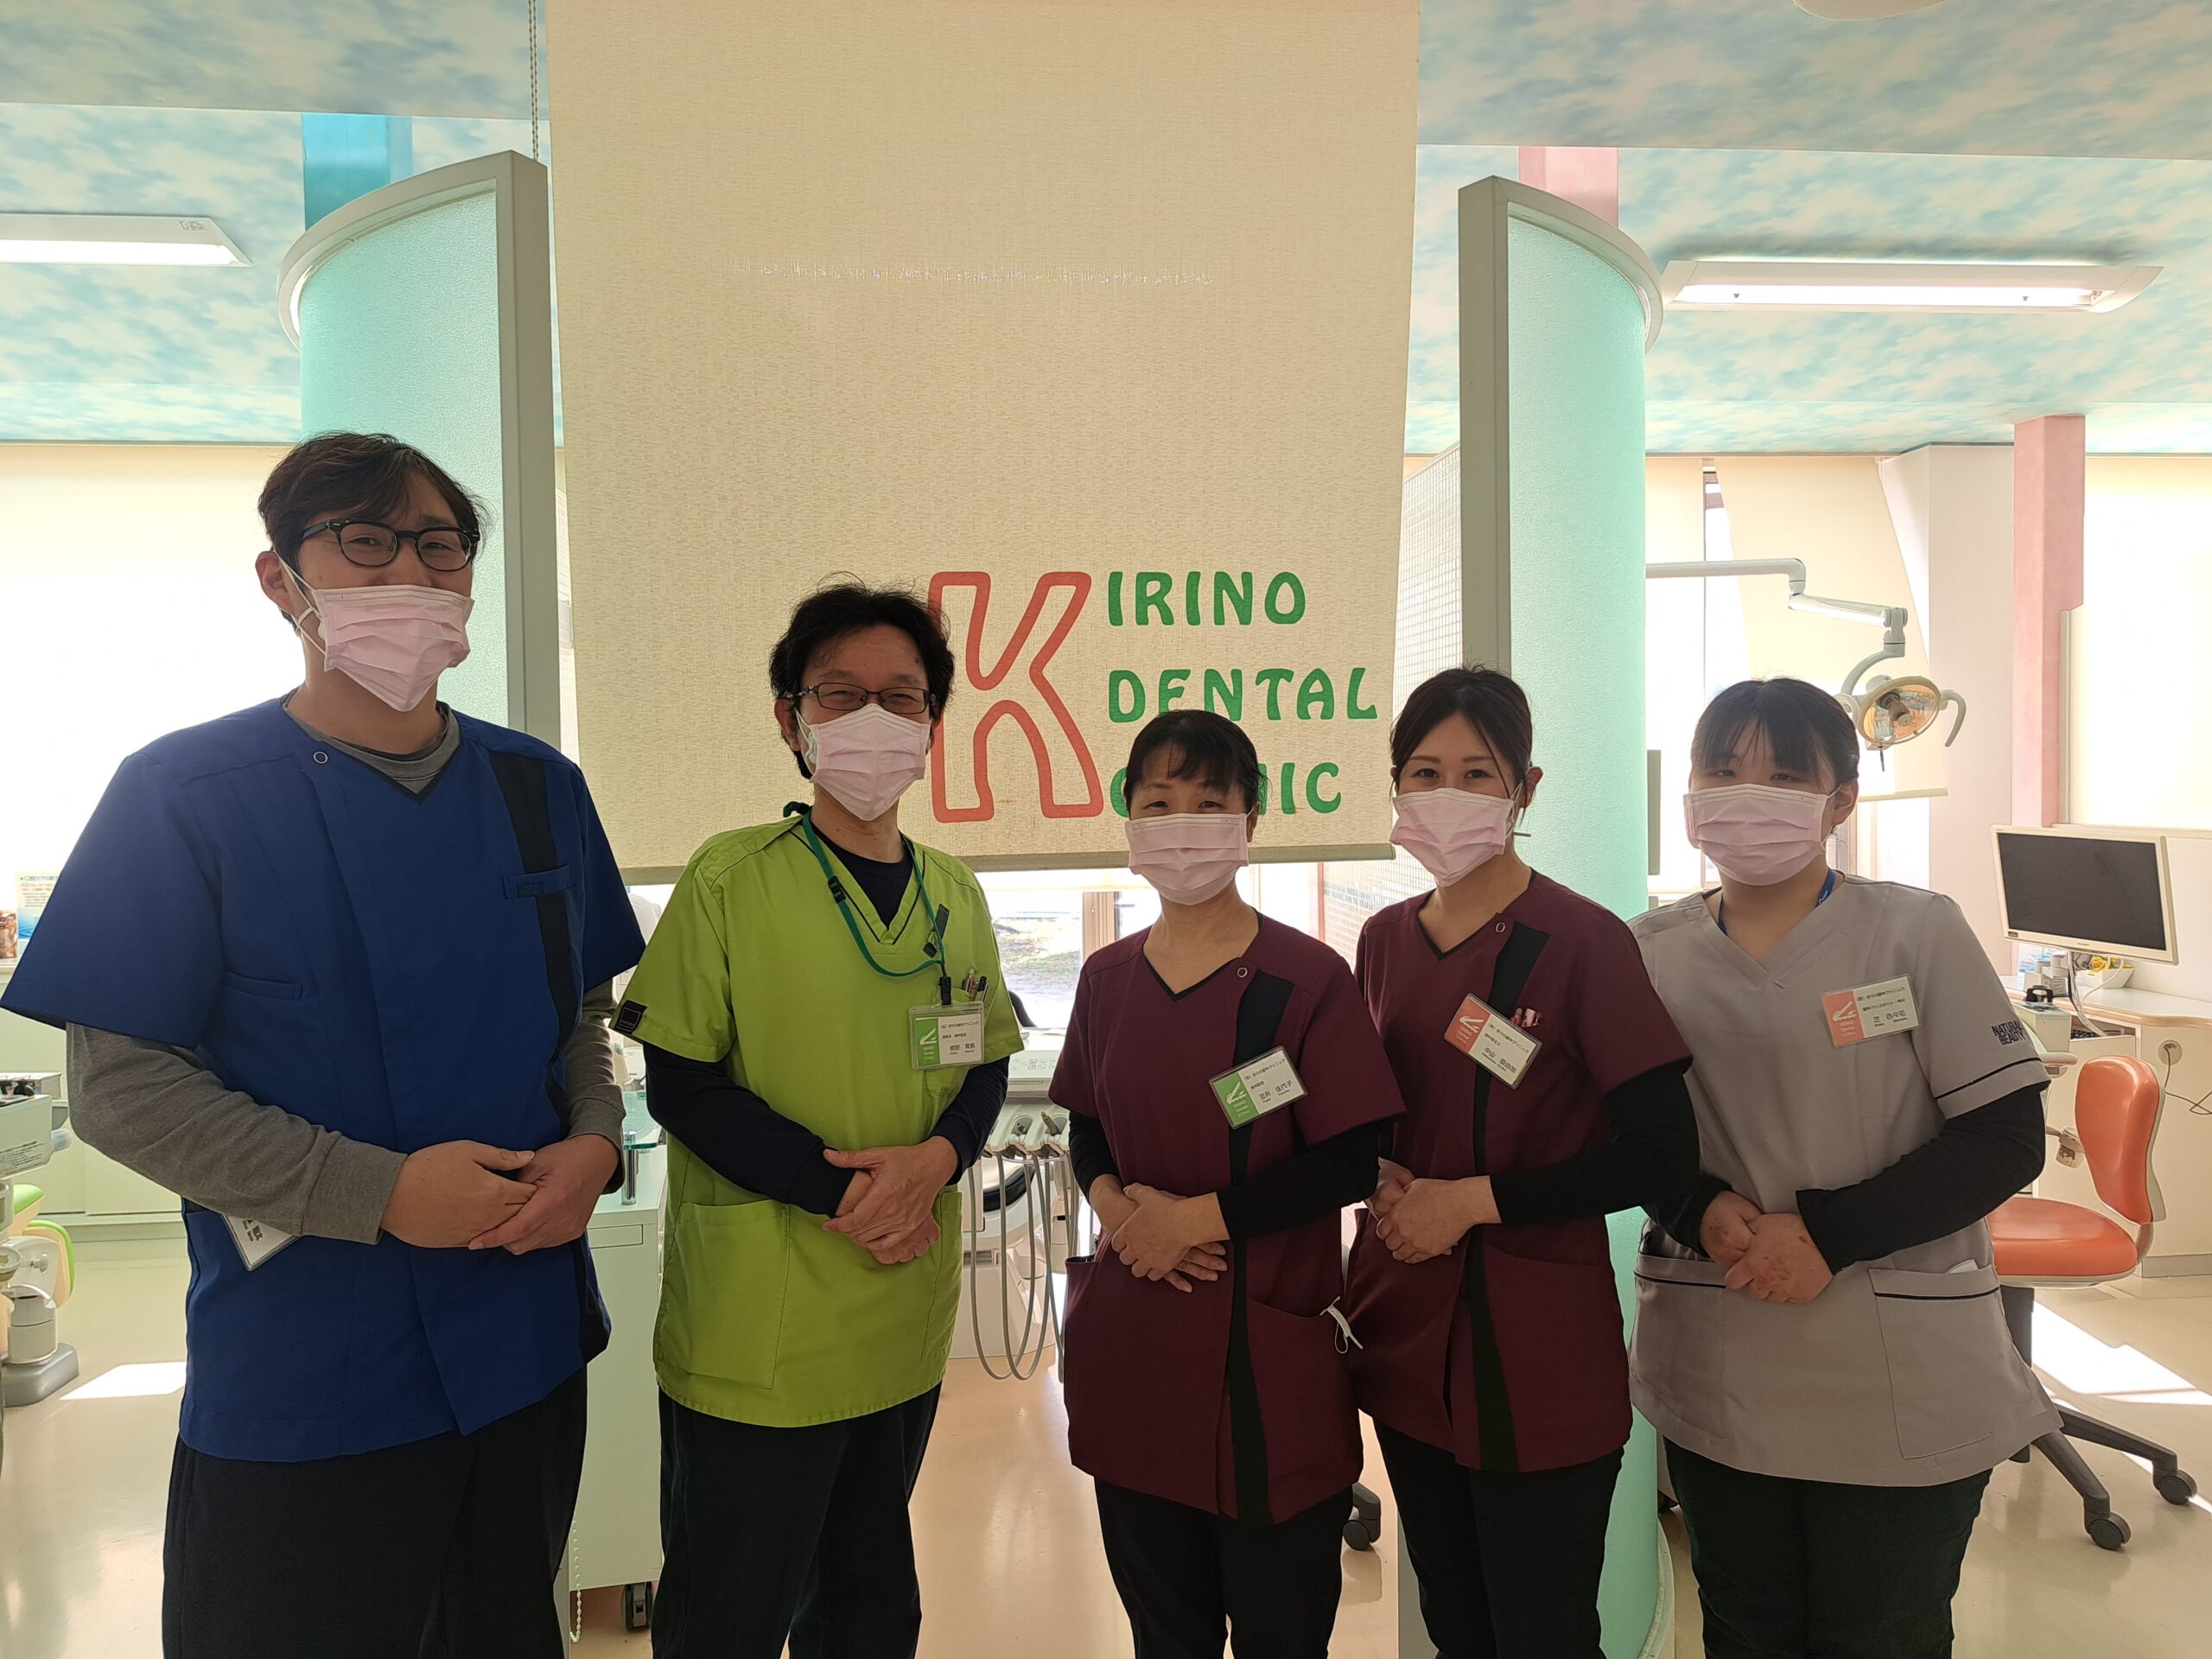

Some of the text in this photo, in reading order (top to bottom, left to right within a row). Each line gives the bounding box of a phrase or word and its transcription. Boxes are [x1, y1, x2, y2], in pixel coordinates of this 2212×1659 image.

[1107, 571, 1306, 626] IRINO
[1108, 667, 1378, 723] DENTAL
[1991, 1020, 2024, 1037] NATURAL
[1998, 1031, 2026, 1046] BEAUTY
